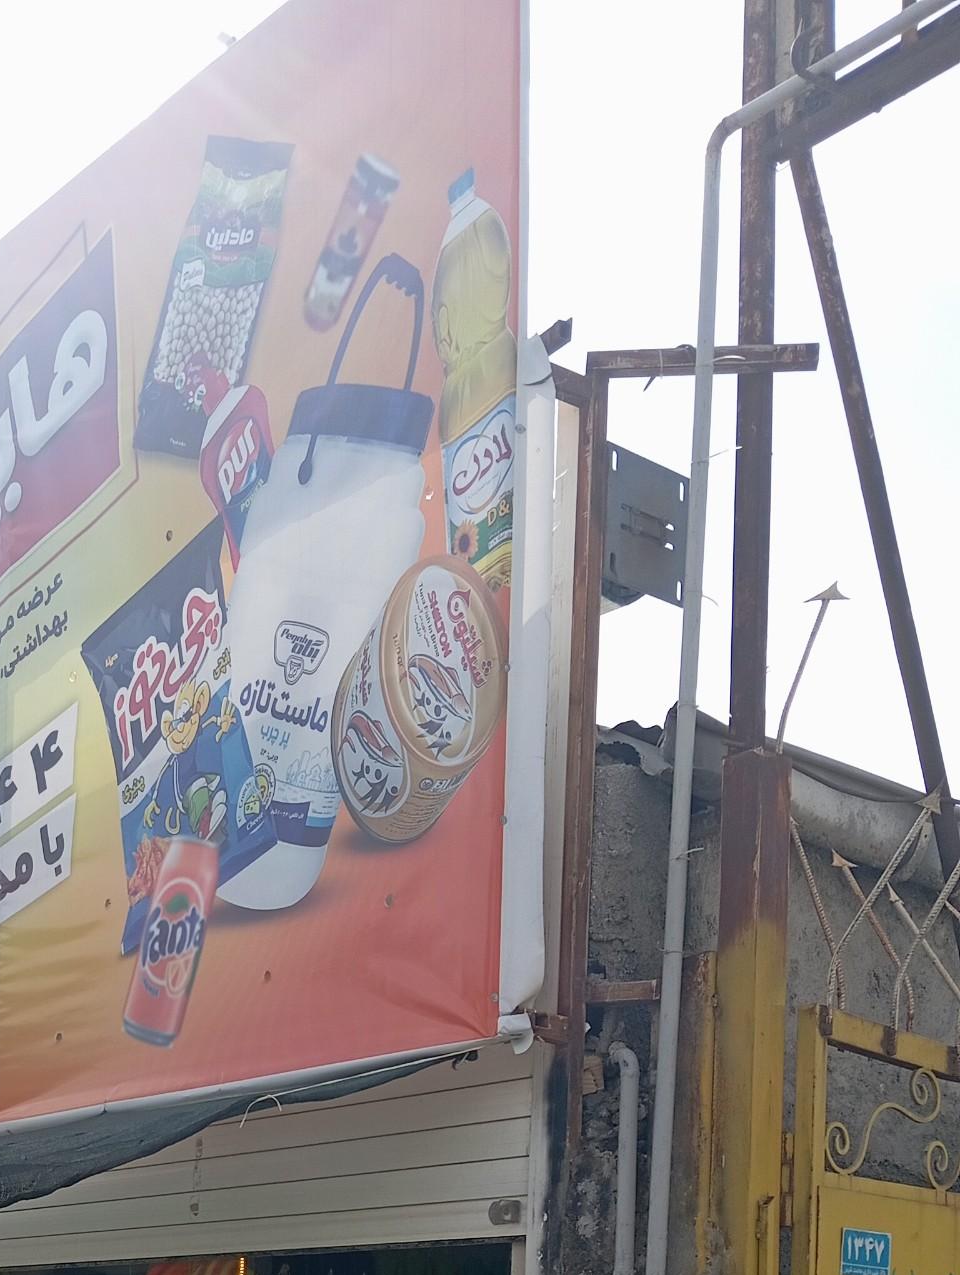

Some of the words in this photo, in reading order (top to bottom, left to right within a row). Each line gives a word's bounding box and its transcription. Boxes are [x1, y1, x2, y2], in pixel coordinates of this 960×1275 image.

[218, 418, 255, 505] pur
[452, 423, 513, 496] لادن
[17, 572, 63, 619] عرضه
[240, 679, 276, 717] تازه
[271, 691, 329, 733] ماست
[260, 725, 279, 747] چرب
[40, 823, 65, 877] با
[847, 1235, 885, 1264] ۱۳۴۷
